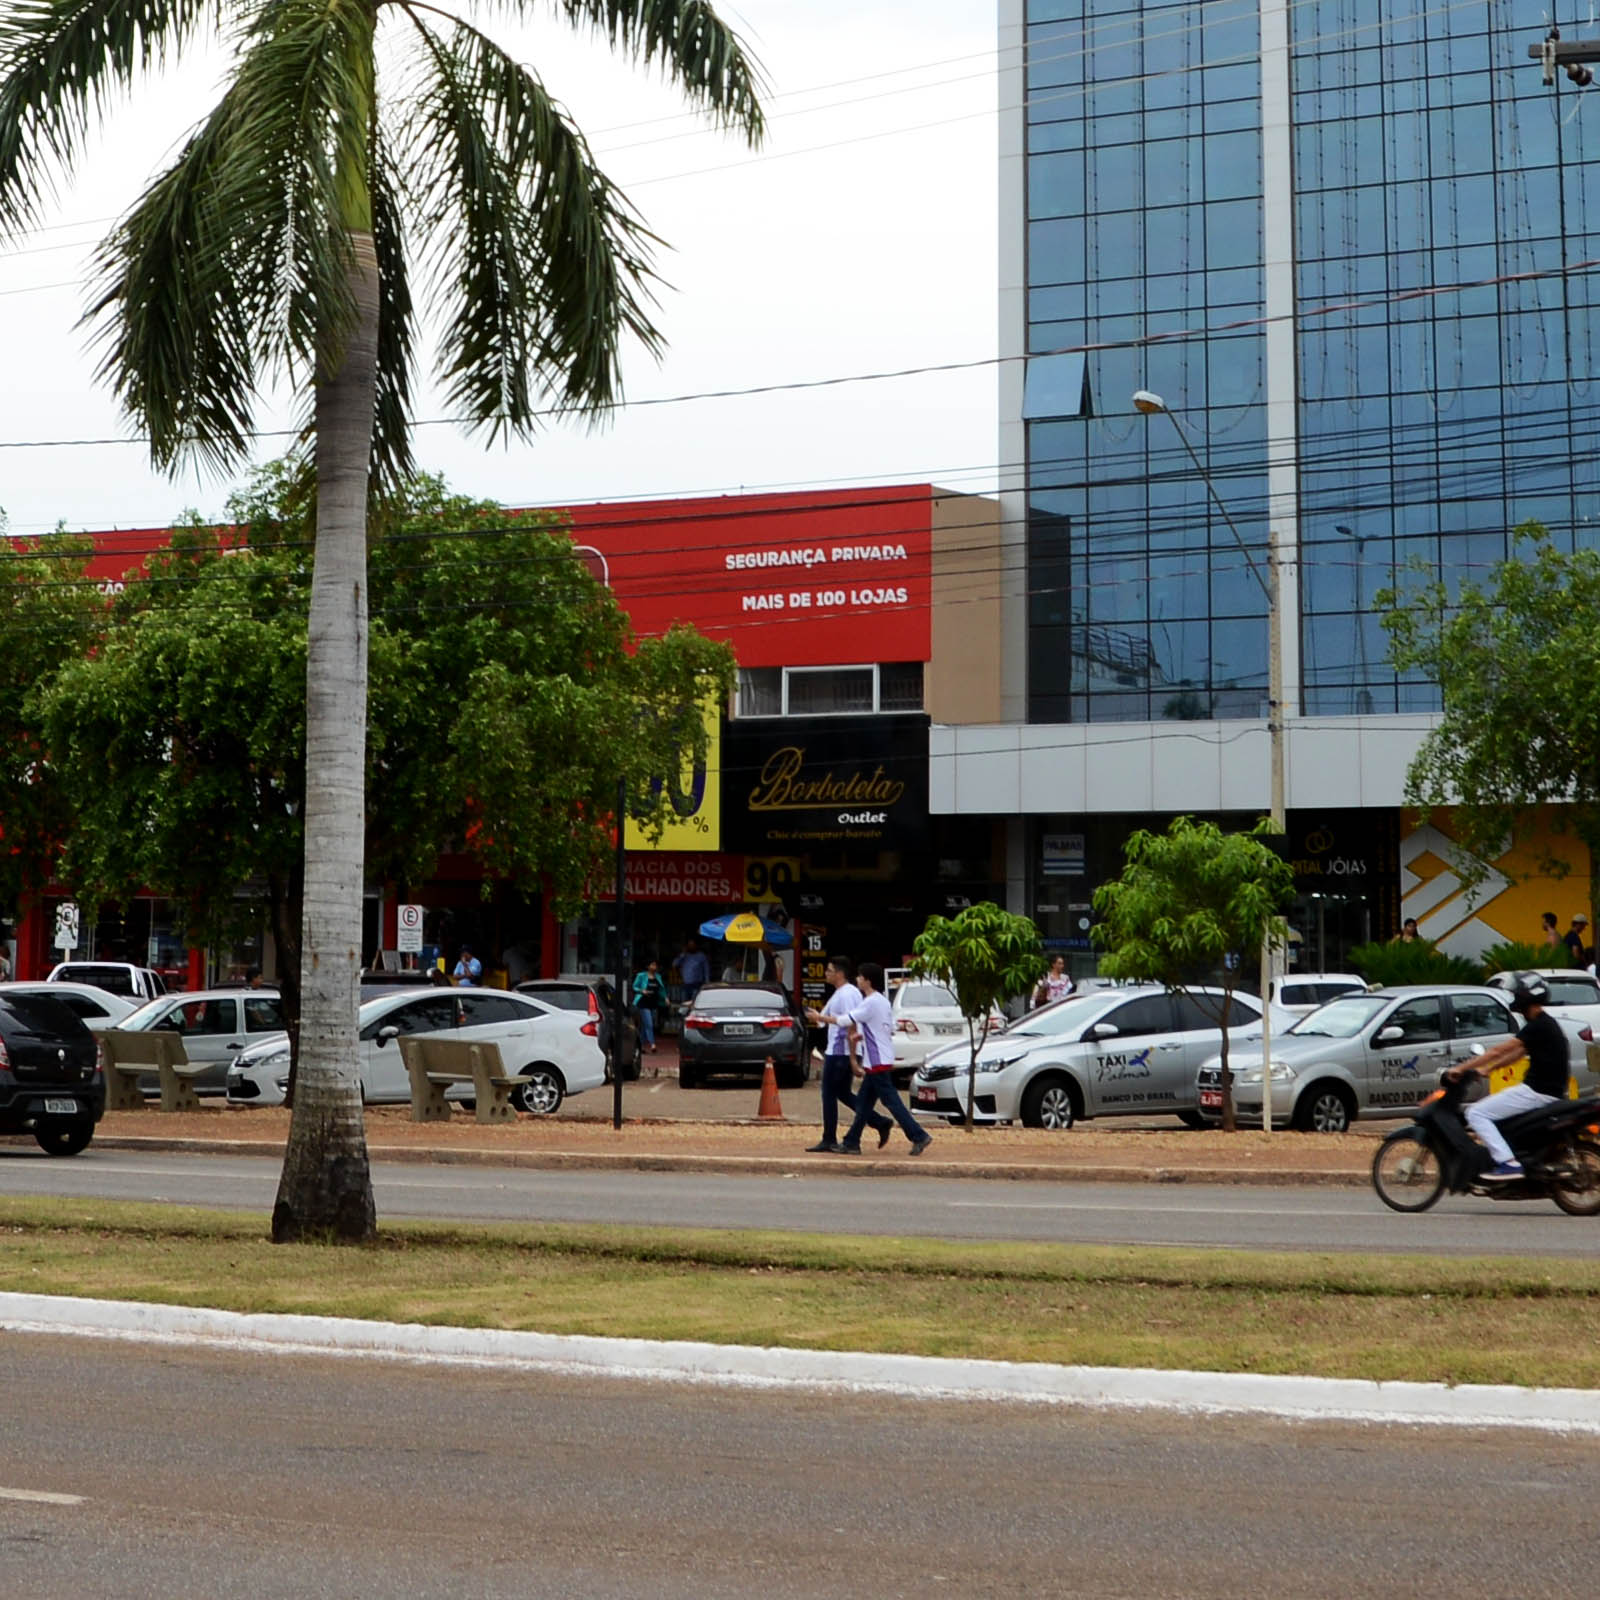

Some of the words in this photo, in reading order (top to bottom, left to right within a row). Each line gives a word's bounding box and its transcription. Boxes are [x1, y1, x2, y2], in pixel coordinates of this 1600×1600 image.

[725, 548, 827, 570] SEGURANÇA
[831, 545, 908, 562] PRIVADA
[742, 593, 785, 611] MAIS
[789, 592, 811, 608] DE
[816, 590, 846, 607] 100
[851, 588, 908, 605] LOJAS
[749, 746, 905, 811] Borboleta
[837, 811, 888, 824] Outlet
[684, 861, 723, 875] DOS
[407, 910, 414, 923] E
[808, 935, 822, 951] 15
[1102, 1093, 1131, 1104] BANCO
[1133, 1093, 1145, 1102] DO
[1147, 1091, 1177, 1101] BRASIL
[1369, 1091, 1400, 1104] BANCO
[1402, 1090, 1416, 1103] DO
